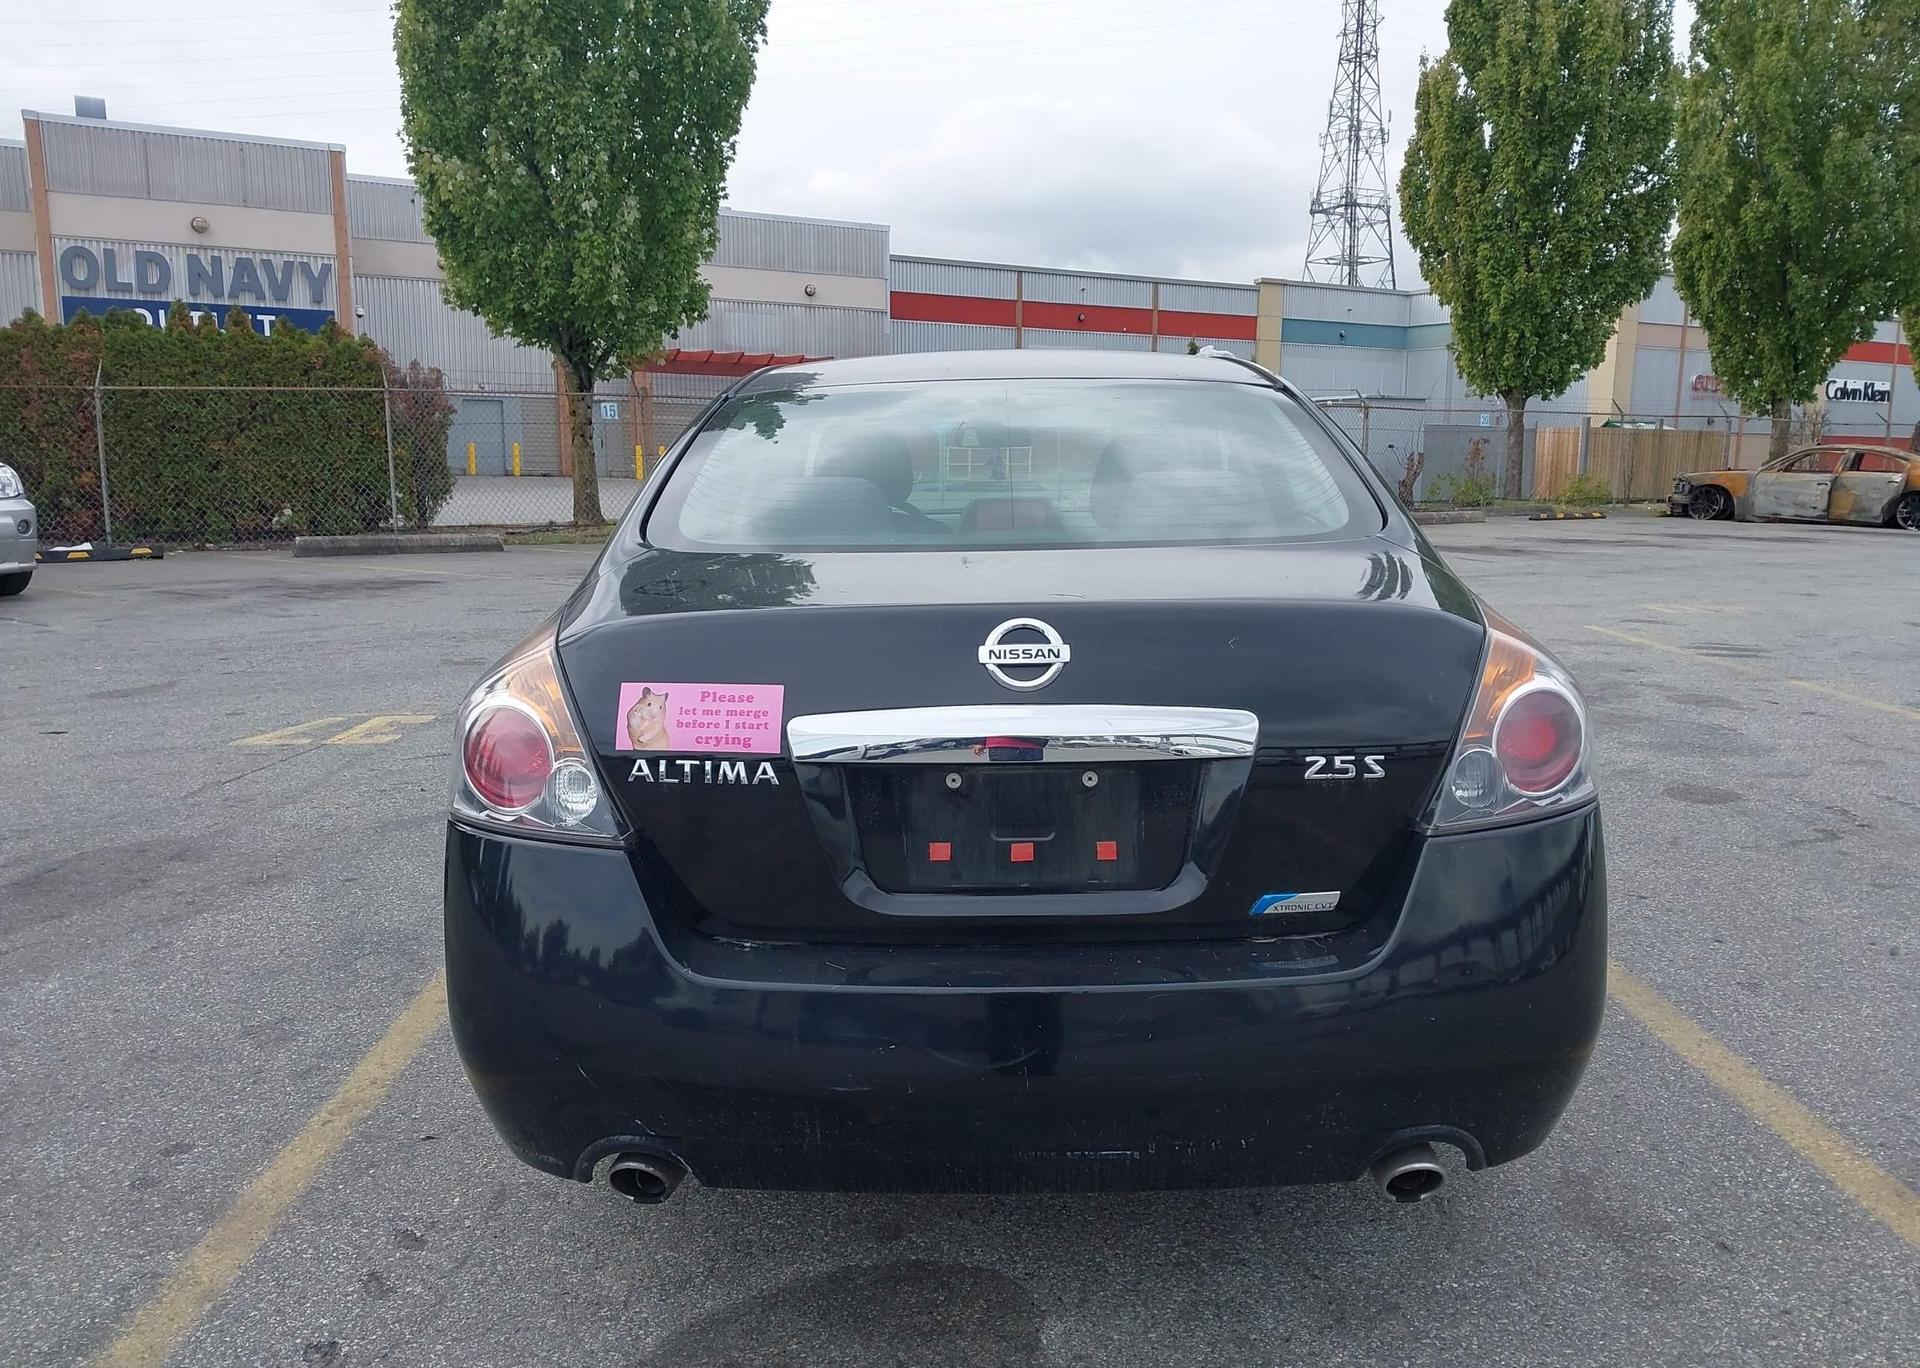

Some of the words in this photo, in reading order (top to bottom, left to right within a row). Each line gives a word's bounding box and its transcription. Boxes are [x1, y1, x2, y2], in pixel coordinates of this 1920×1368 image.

[59, 245, 172, 295] OLD
[186, 252, 332, 303] NAVY
[1826, 379, 1862, 401] Calvin
[1863, 381, 1890, 403] Klein
[602, 404, 616, 418] 15
[988, 648, 1061, 660] NISSAN
[699, 691, 755, 704] Please
[678, 706, 697, 716] let
[702, 708, 721, 717] me
[725, 709, 769, 720] merge
[676, 719, 721, 730] before
[724, 719, 731, 730] I
[734, 720, 770, 731] start
[695, 734, 752, 749] crying
[627, 759, 780, 786] ALTIMA
[1363, 755, 1386, 779] S
[1273, 903, 1313, 912] XTRONIC
[1315, 902, 1335, 910] CVT
